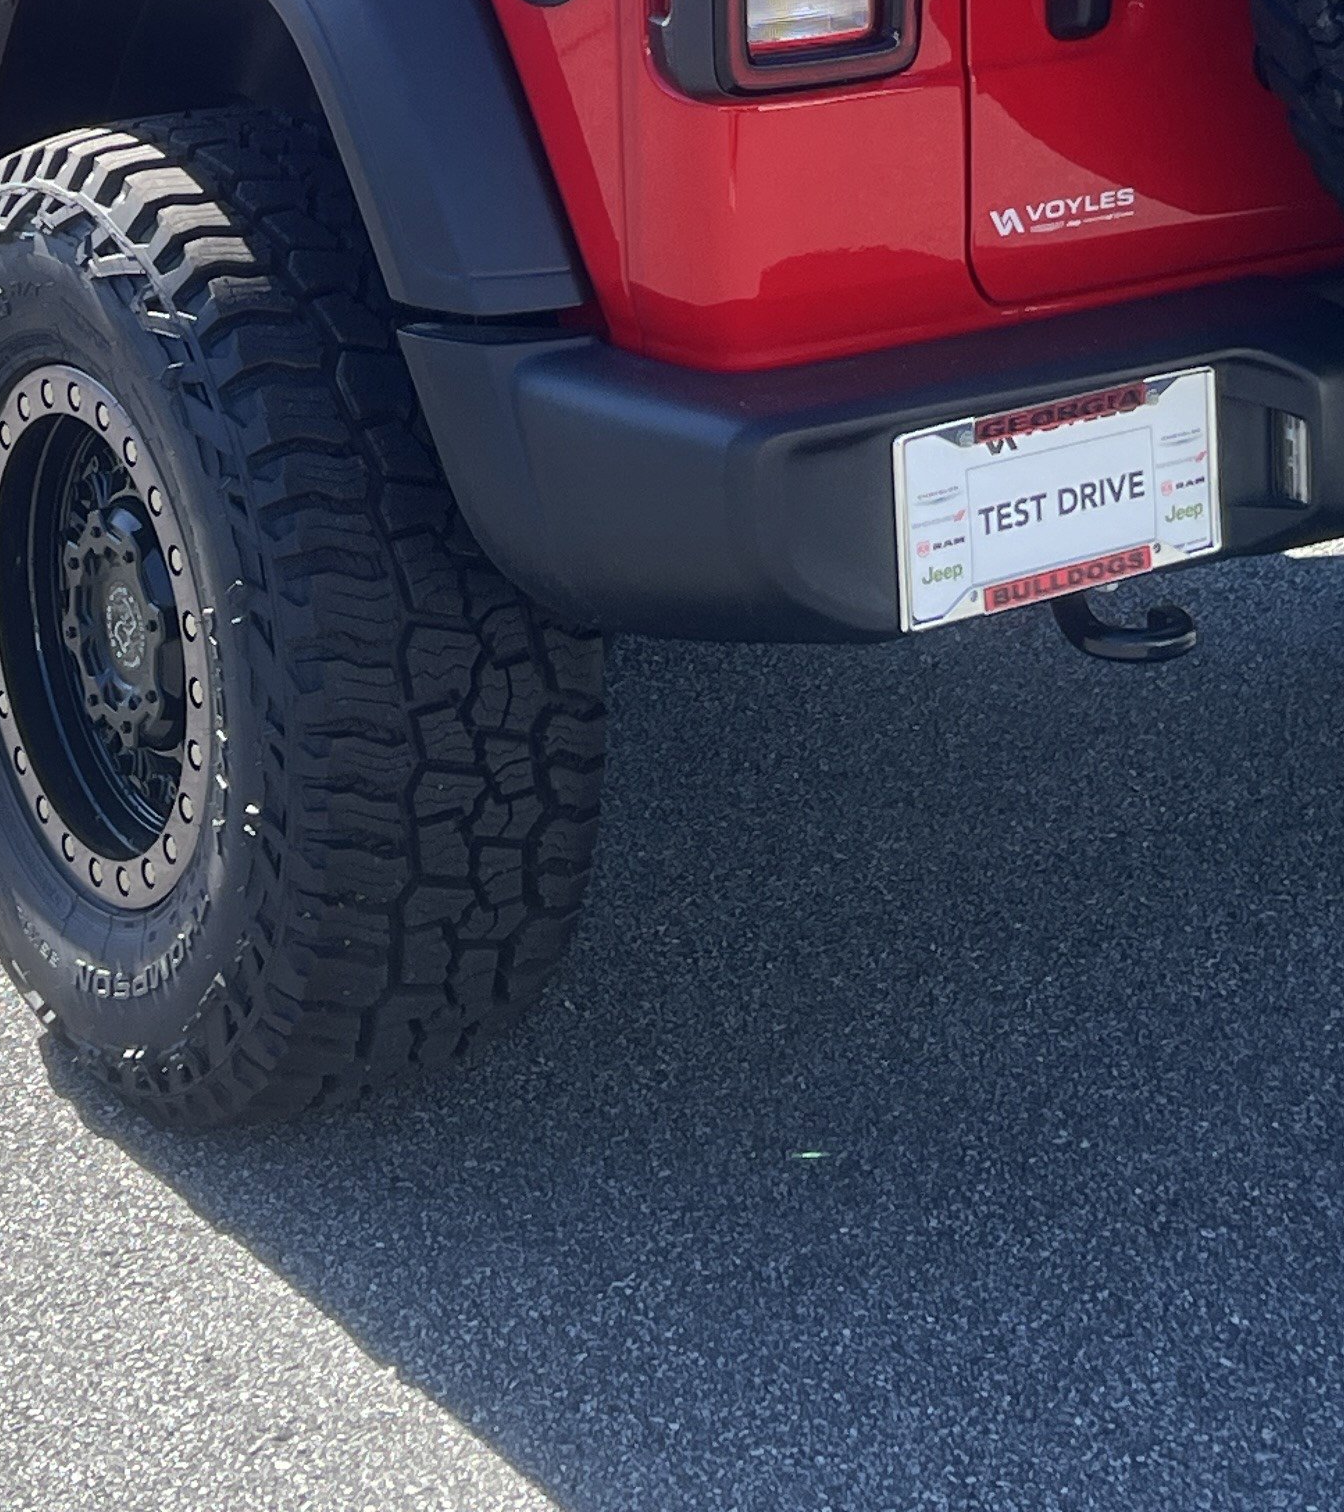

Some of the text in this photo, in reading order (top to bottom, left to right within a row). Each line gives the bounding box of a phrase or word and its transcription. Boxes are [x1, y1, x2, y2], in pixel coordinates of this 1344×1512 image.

[1025, 187, 1135, 222] VOYLES
[982, 390, 1141, 437] GEORGIA
[978, 492, 1047, 535] TEST
[1058, 470, 1146, 516] DRIVE
[1164, 502, 1204, 523] Jeep
[921, 563, 963, 585] Jeep
[993, 551, 1145, 606] BULLDOGS
